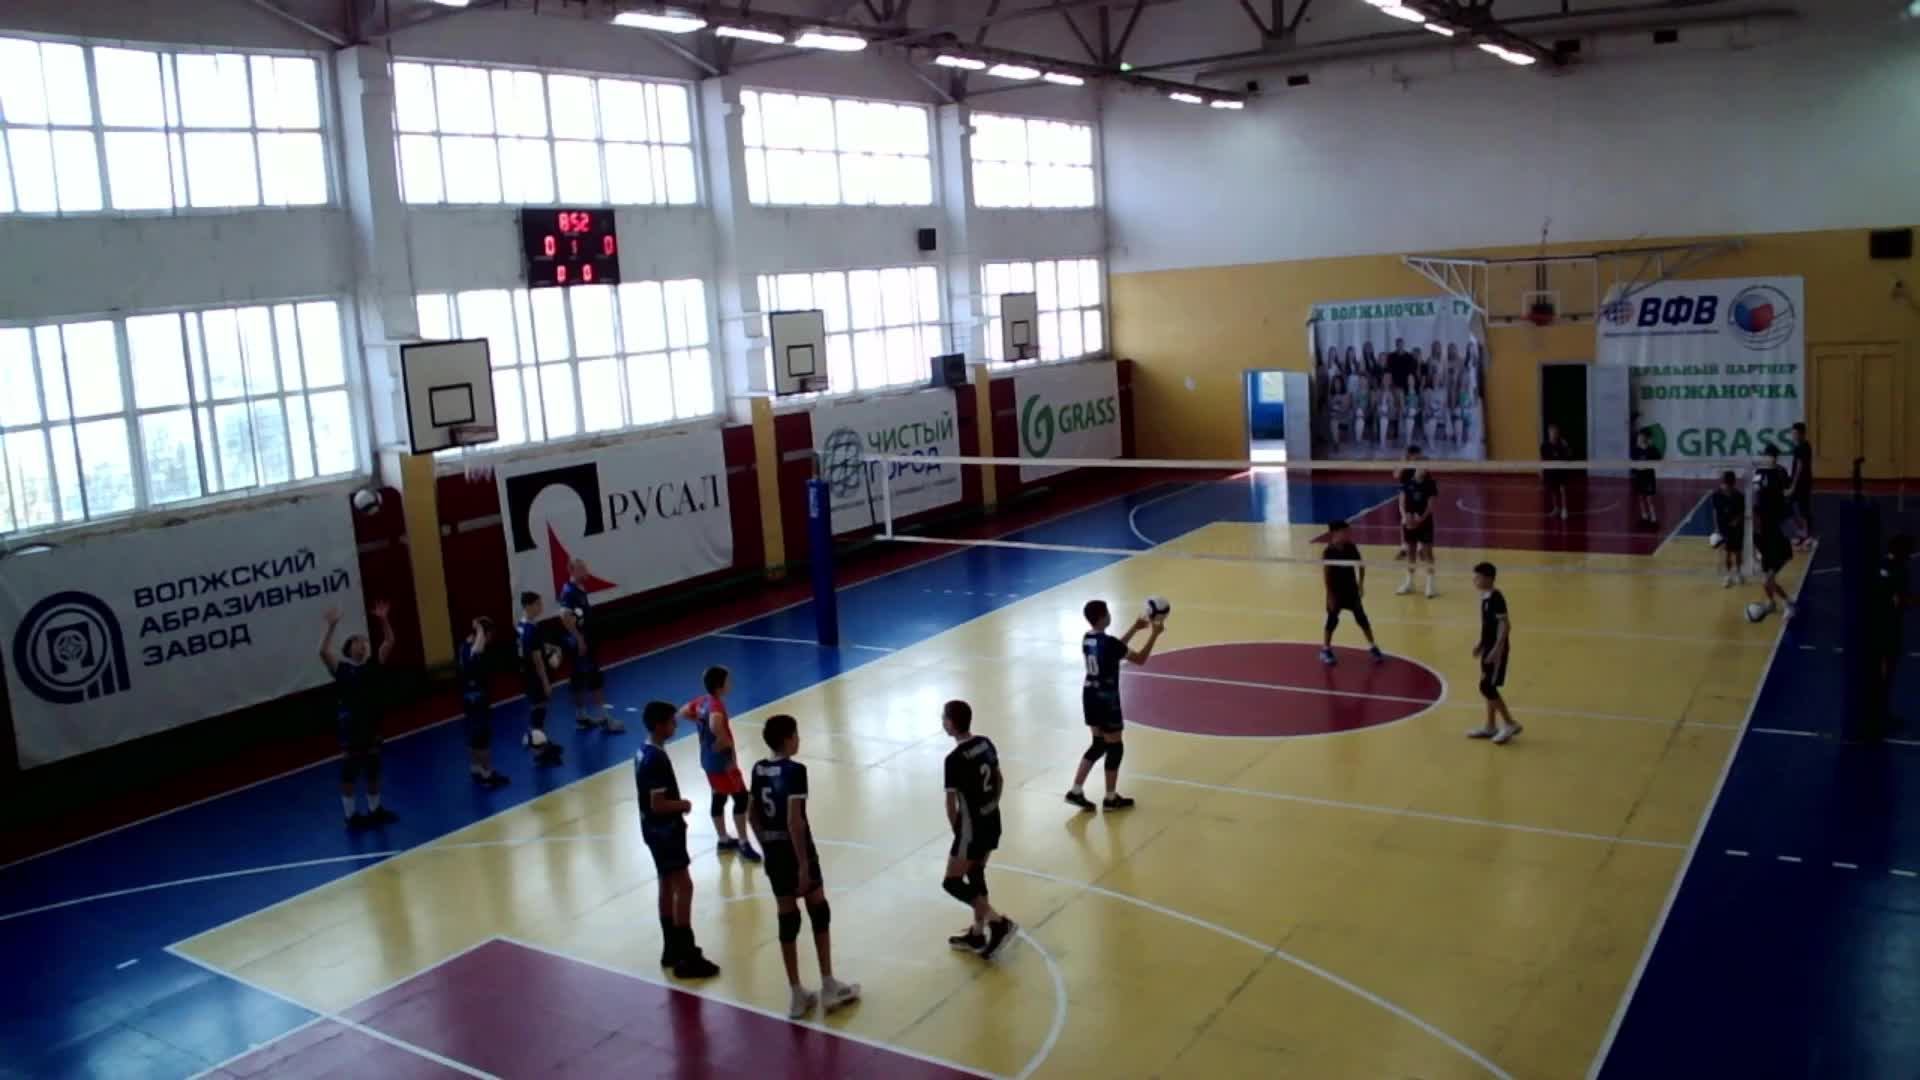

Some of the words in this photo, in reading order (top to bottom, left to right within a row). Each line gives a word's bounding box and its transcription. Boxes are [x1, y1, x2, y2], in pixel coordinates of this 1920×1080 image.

[544, 235, 556, 256] 0
[603, 235, 614, 256] 0
[1331, 301, 1435, 321] ВОЛЖАНОЧКА
[1637, 295, 1719, 327] ВФВ
[1726, 363, 1797, 376] ПАРТНЕР
[1641, 384, 1798, 401] ВОЛЖАНОЧКА
[1057, 396, 1116, 434] GRASS
[867, 411, 953, 453] ЧИСТЫЙ
[1676, 427, 1796, 458] GRASS
[608, 474, 721, 530] РУСАЛ
[134, 548, 318, 608] ВОЛЖСКИЙ
[139, 569, 350, 638] АБРАЗИВНЫЙ
[143, 623, 252, 668] ЗАВОД
[980, 763, 993, 793] 2
[761, 786, 777, 818] 5
